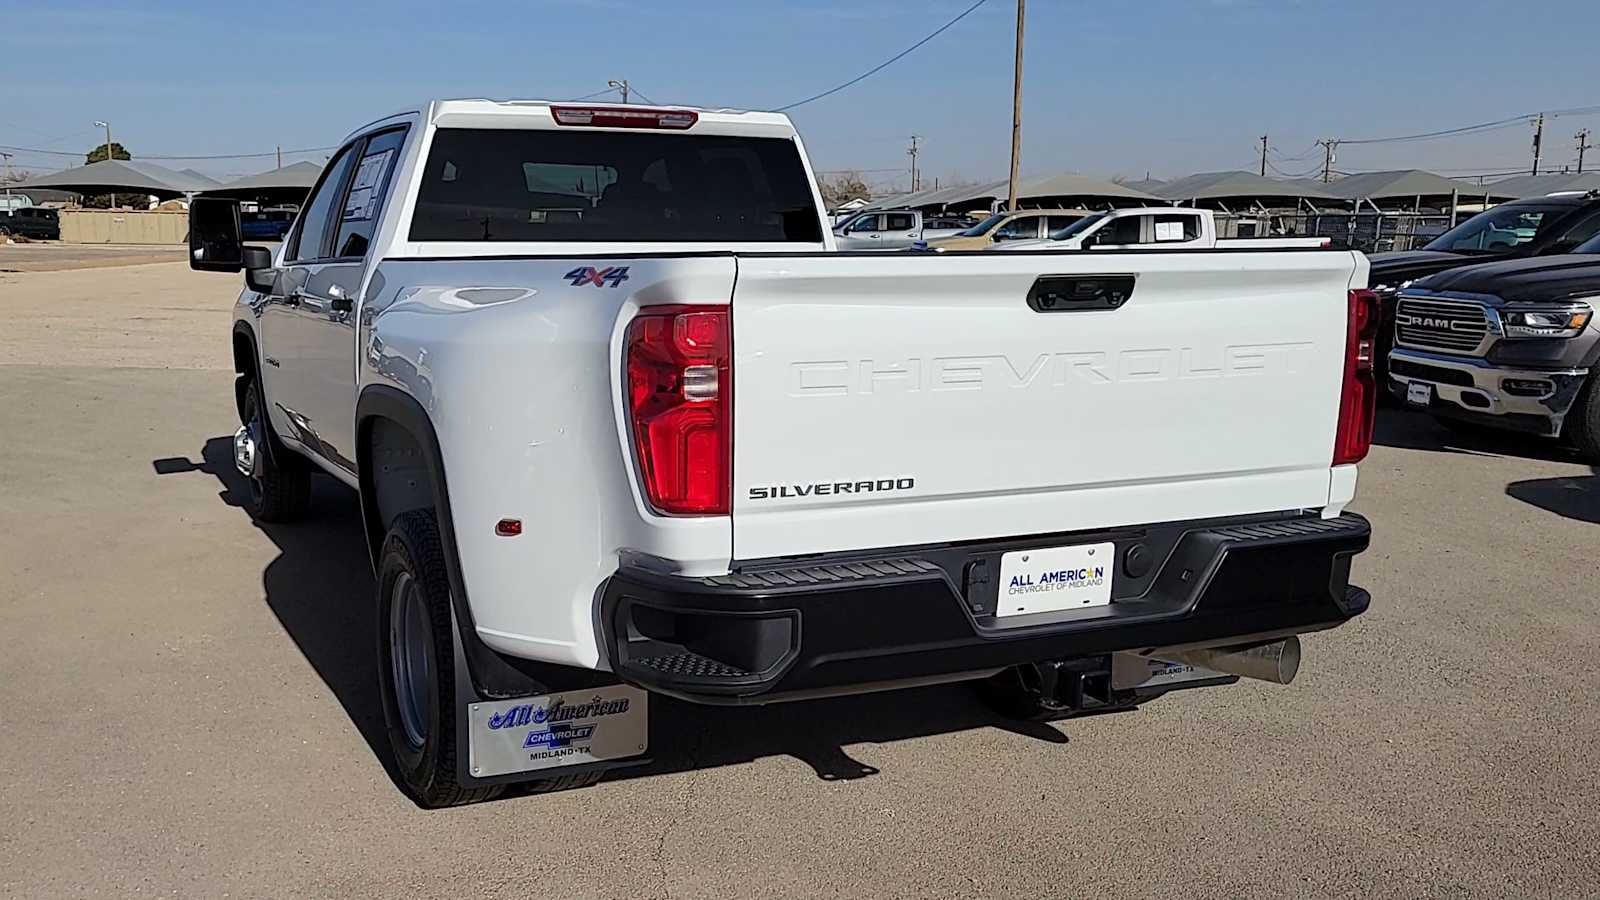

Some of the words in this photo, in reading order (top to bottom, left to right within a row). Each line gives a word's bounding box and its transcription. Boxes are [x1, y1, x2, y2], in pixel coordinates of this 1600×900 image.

[1411, 316, 1449, 329] RAM
[787, 341, 1314, 397] CHEVROLET
[749, 478, 914, 499] SILVERADO
[1008, 583, 1055, 595] CHEVROLET
[1056, 581, 1067, 590] OF
[1069, 578, 1103, 590] MIDLAND
[1010, 574, 1034, 587] ALL
[488, 703, 534, 730] All
[533, 697, 630, 723] American
[530, 727, 593, 744] CHEVROLET
